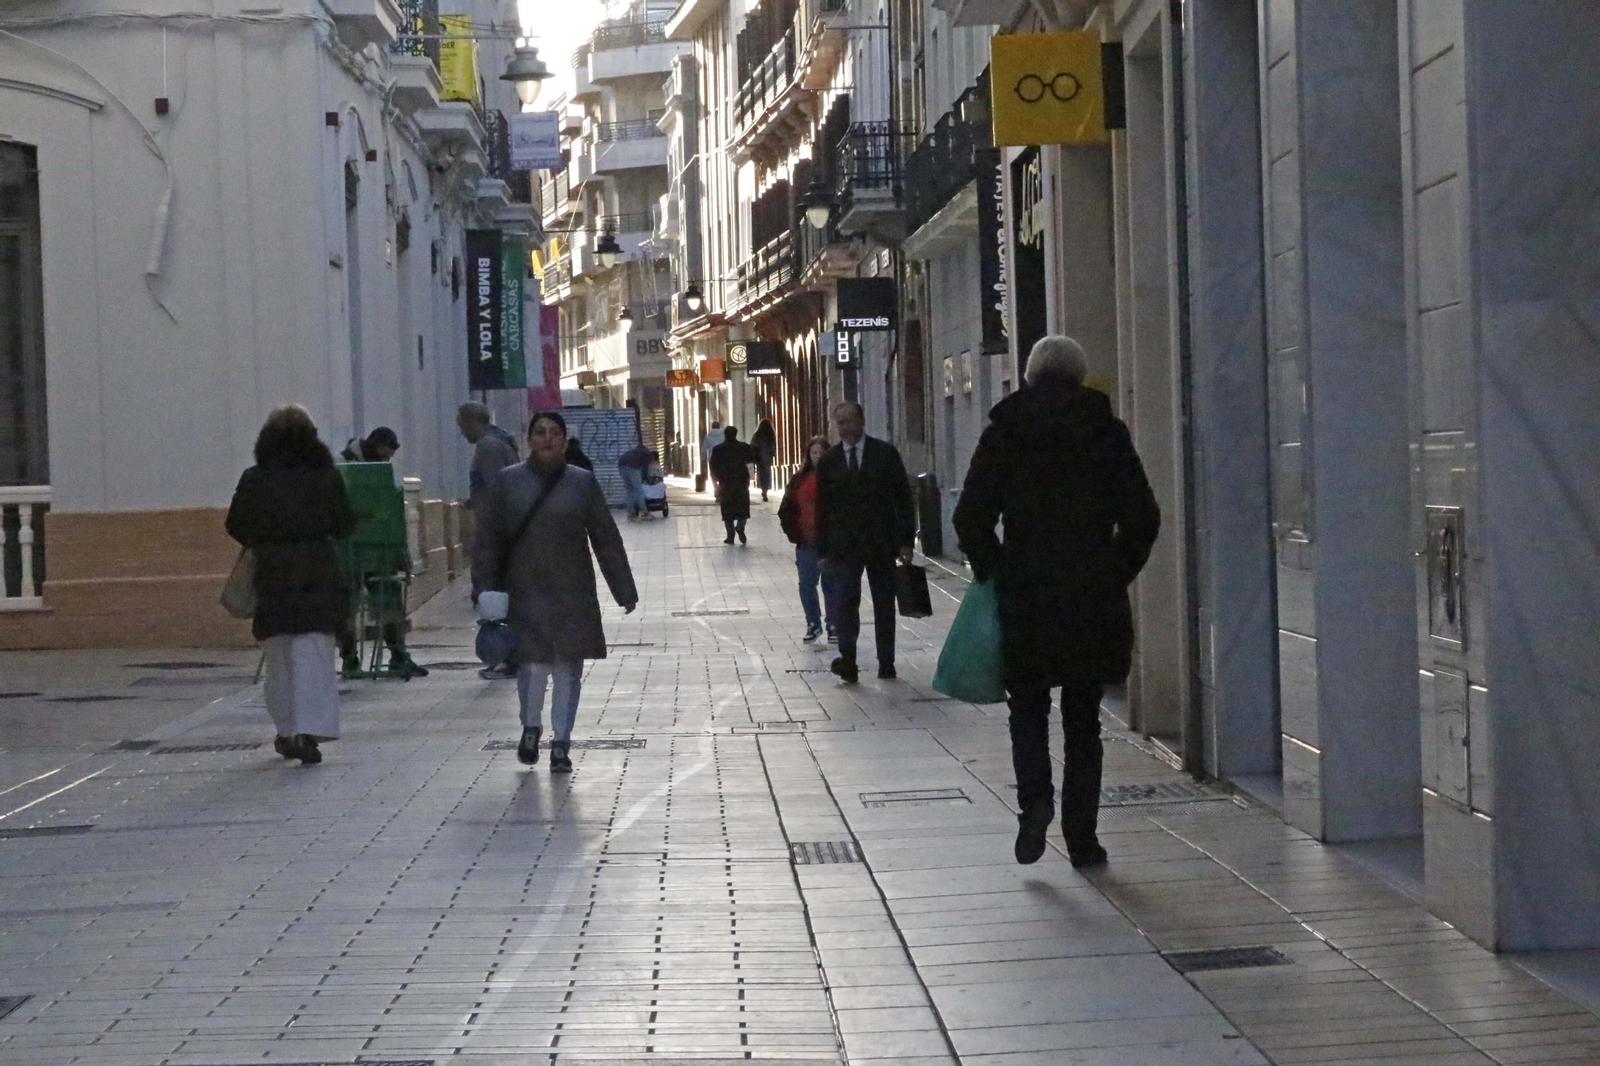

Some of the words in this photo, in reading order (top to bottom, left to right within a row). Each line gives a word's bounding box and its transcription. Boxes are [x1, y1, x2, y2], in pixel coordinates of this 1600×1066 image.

[478, 257, 491, 307] BIMBA
[479, 308, 491, 320] Y
[508, 279, 519, 350] CARCASAS
[479, 323, 492, 361] LOLA
